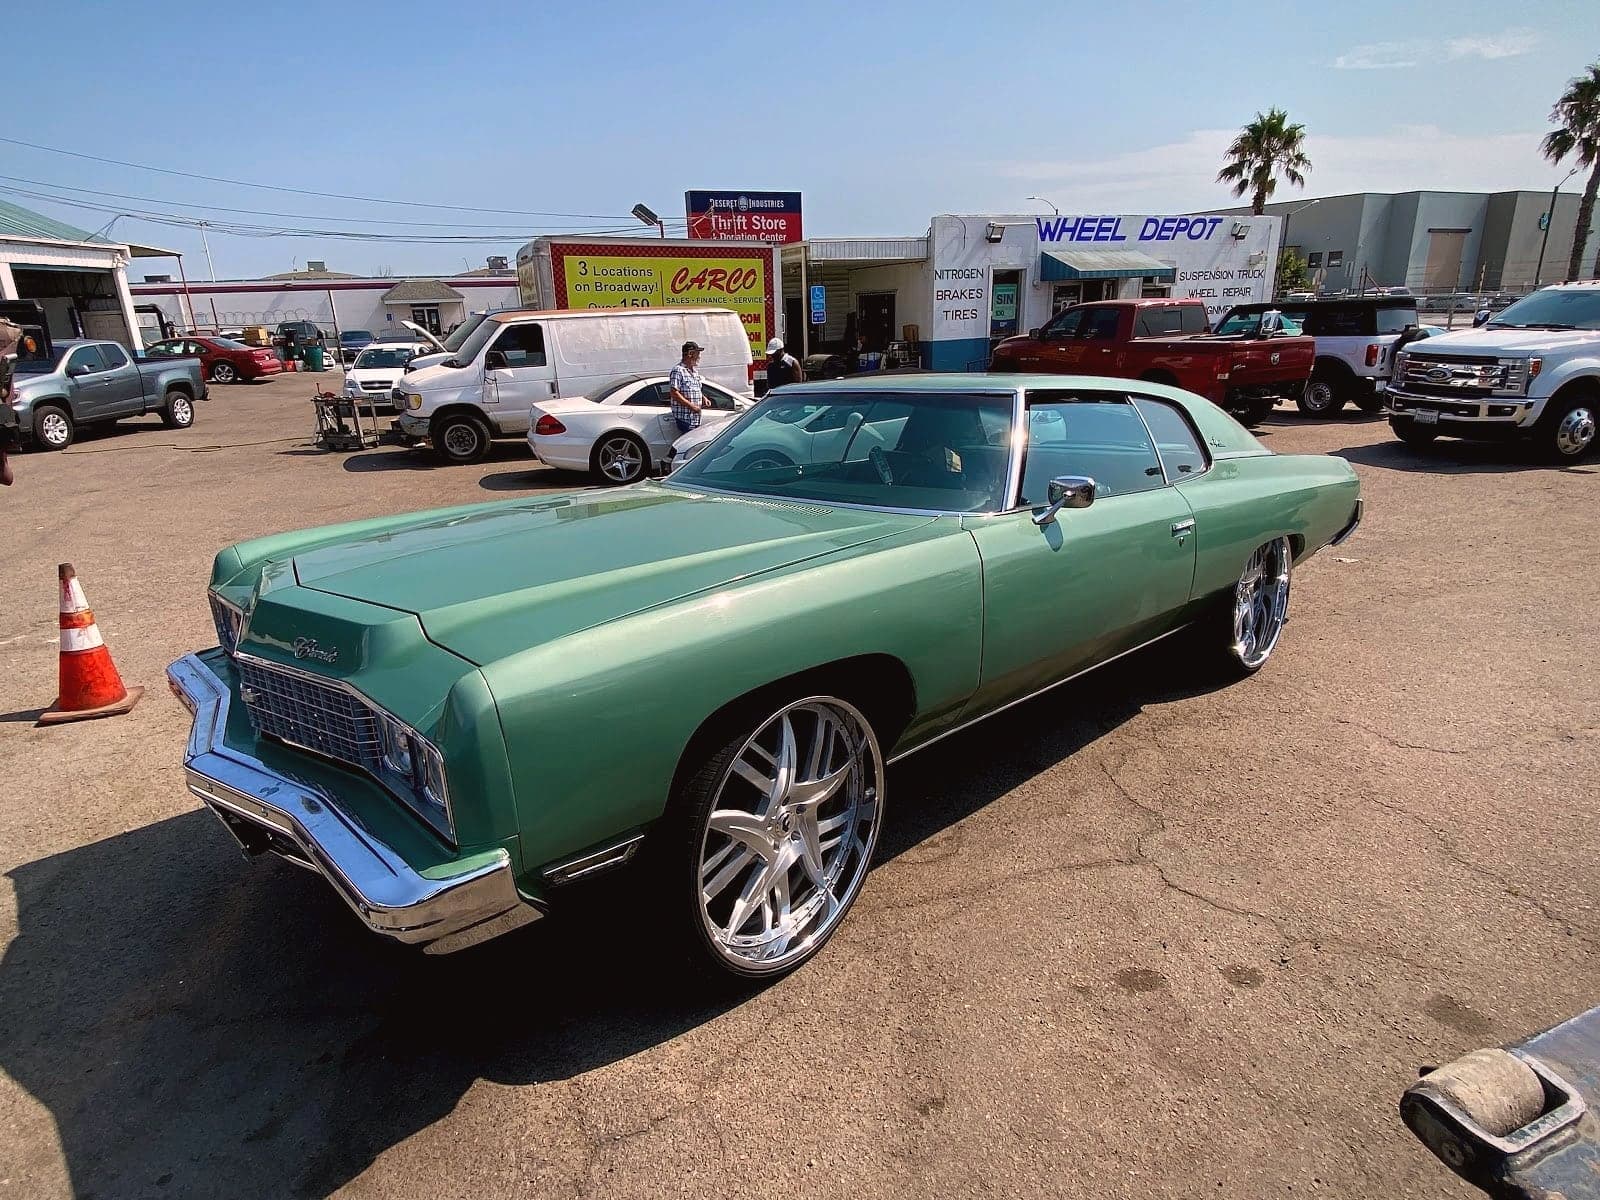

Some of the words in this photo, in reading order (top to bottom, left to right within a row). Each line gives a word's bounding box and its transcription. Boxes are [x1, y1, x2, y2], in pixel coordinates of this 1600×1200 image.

[749, 199, 785, 208] INDUSTRIES
[712, 215, 747, 230] Thrift
[751, 215, 787, 230] Store
[1036, 217, 1126, 242] WHEEL
[1138, 217, 1223, 241] DEPOT
[759, 232, 787, 242] Center
[578, 261, 588, 276] 3
[593, 266, 653, 277] Locations
[934, 268, 984, 280] NITROGEN
[1179, 270, 1234, 281] SUSPENSION
[1237, 268, 1265, 279] TRUCK
[671, 266, 758, 294] CARCO
[575, 283, 590, 292] on
[594, 281, 659, 295] Broadway!
[1188, 288, 1218, 298] WHEEL
[1222, 287, 1252, 297] REPAIR
[666, 297, 690, 305] SALES
[696, 297, 727, 305] FINANCE
[733, 296, 763, 304] SERVICE
[936, 288, 984, 301] BRAKES
[996, 293, 1014, 305] SIN
[943, 308, 979, 320] TIRES
